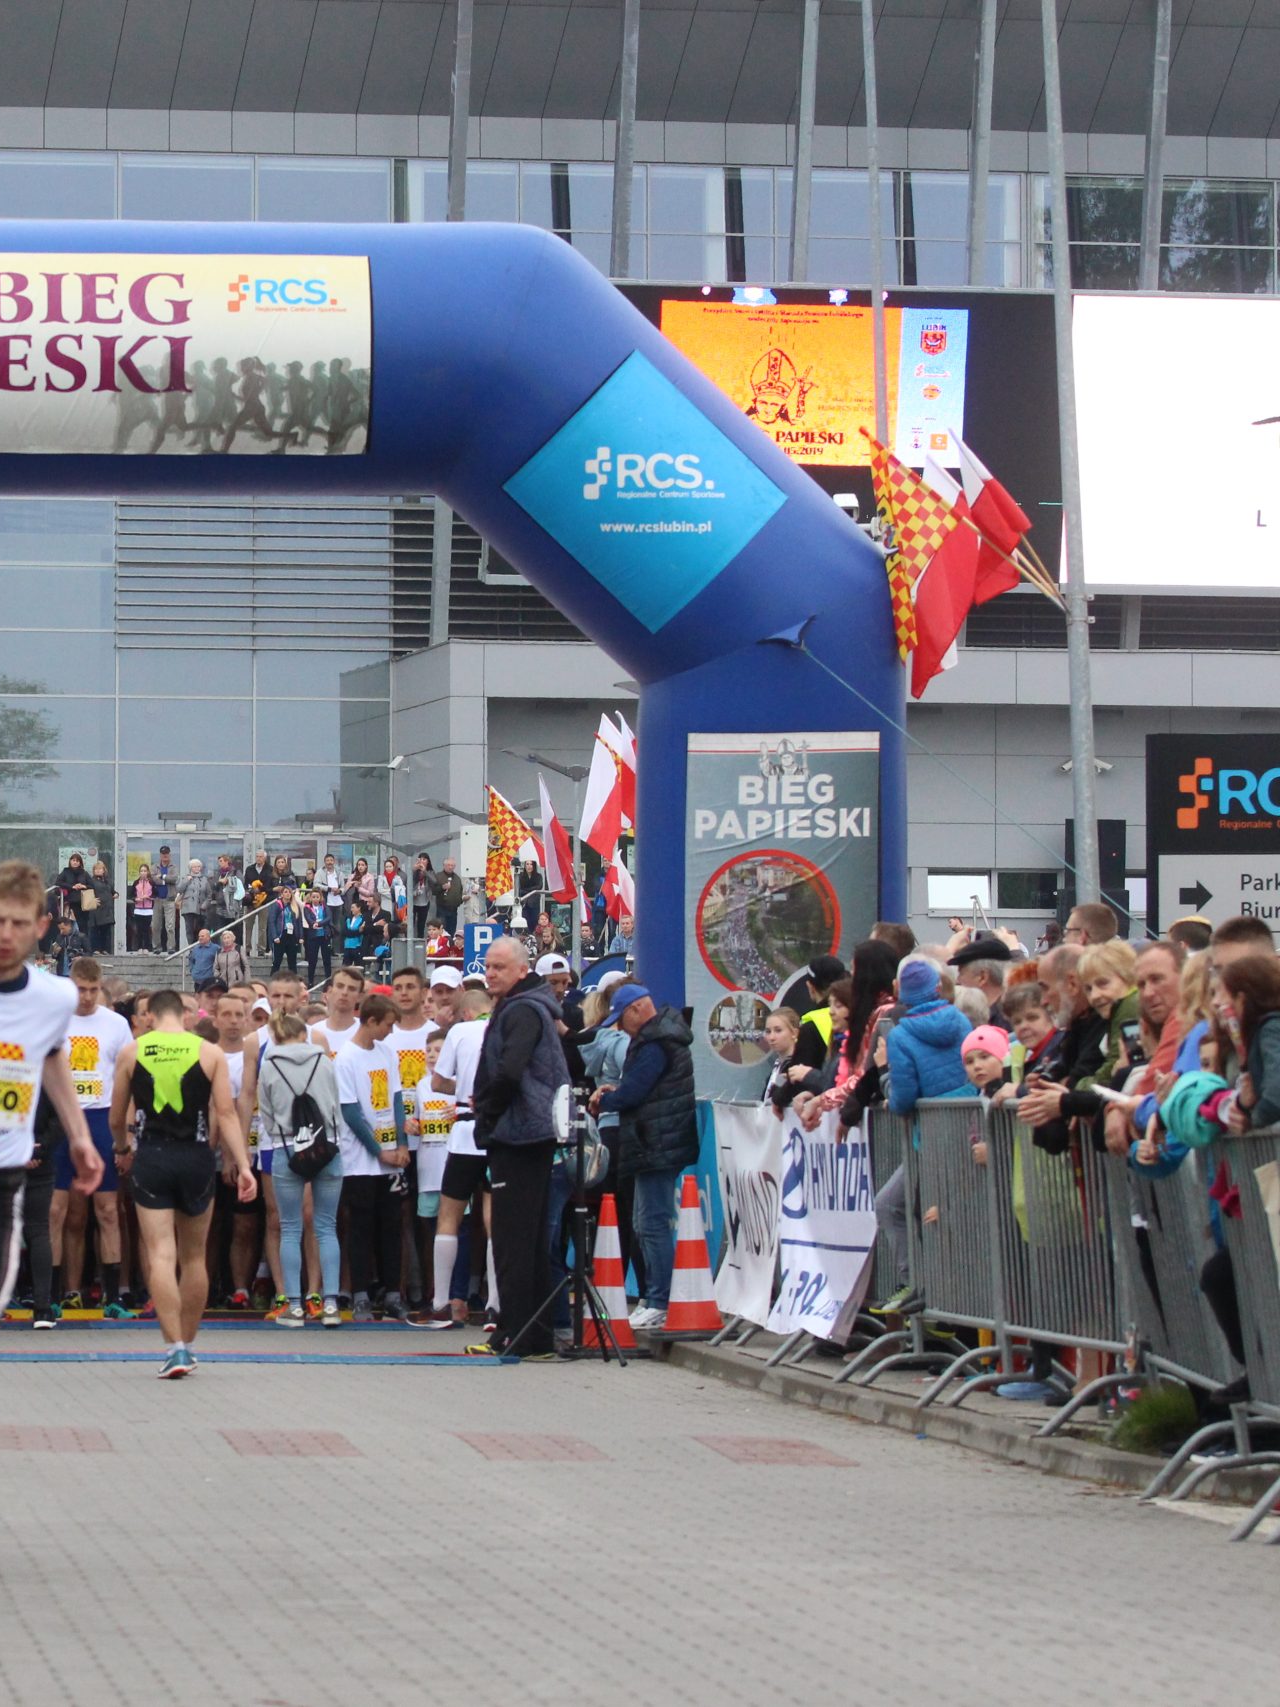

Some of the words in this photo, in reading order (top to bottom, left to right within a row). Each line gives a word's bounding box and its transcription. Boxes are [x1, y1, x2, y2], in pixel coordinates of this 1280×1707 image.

[775, 431, 844, 445] PAPIESKI
[783, 447, 824, 456] 05.2019
[600, 521, 712, 534] www.rcslubin.pl
[738, 773, 835, 806] BIEG
[694, 807, 870, 840] PAPIESKI
[1219, 819, 1273, 831] Regionalne
[474, 925, 493, 953] P
[74, 1083, 94, 1095] 91
